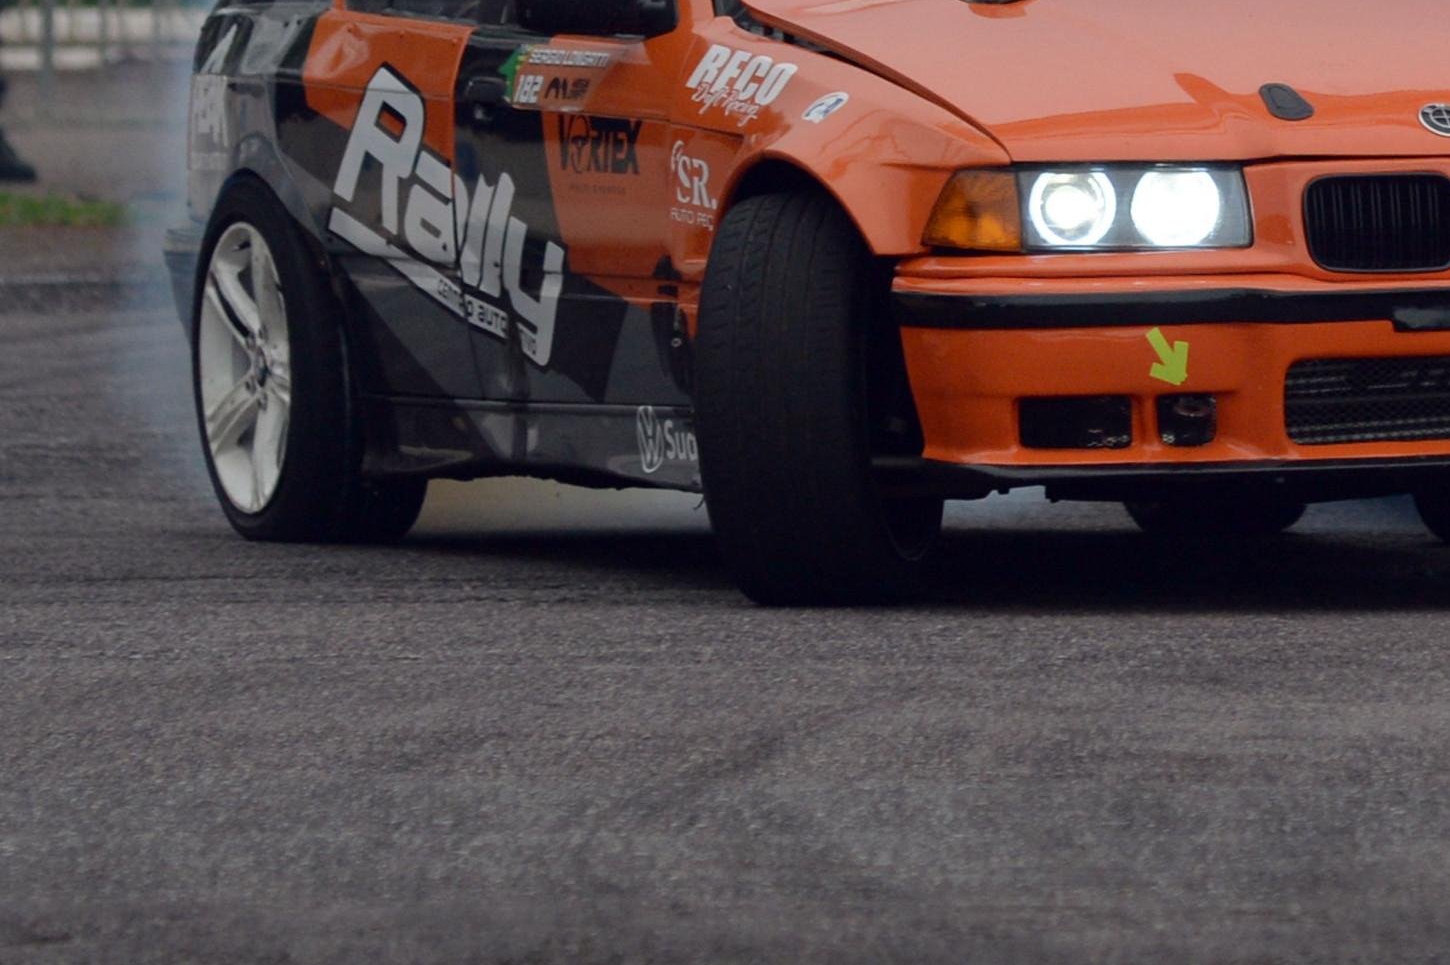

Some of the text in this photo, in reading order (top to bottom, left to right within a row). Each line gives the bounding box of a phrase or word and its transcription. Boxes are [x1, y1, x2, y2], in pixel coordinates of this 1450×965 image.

[514, 74, 544, 103] 182
[557, 114, 643, 175] VORTEX
[332, 65, 565, 366] Rally
